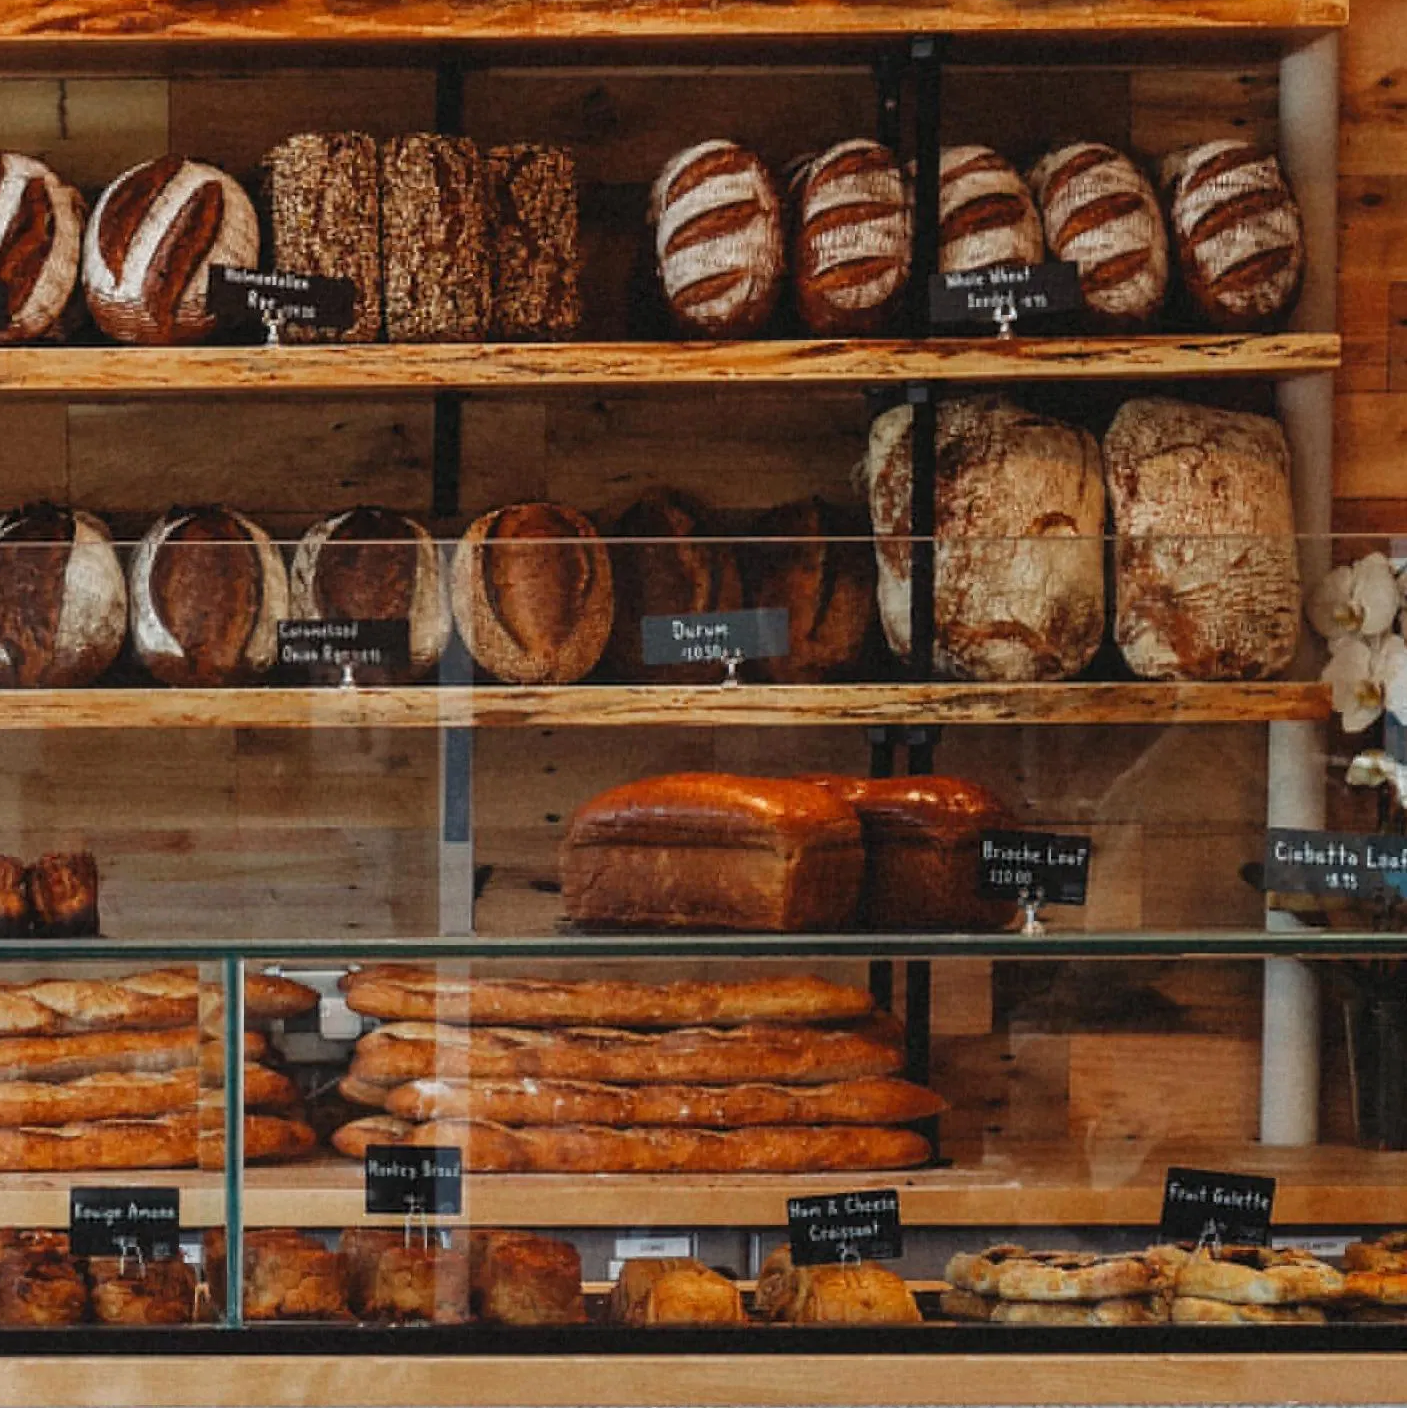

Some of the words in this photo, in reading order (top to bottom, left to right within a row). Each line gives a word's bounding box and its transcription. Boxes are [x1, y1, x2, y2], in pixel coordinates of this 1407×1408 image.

[672, 620, 730, 641] Durum
[983, 841, 1041, 863] Brioche
[1048, 844, 1087, 866] Loaf
